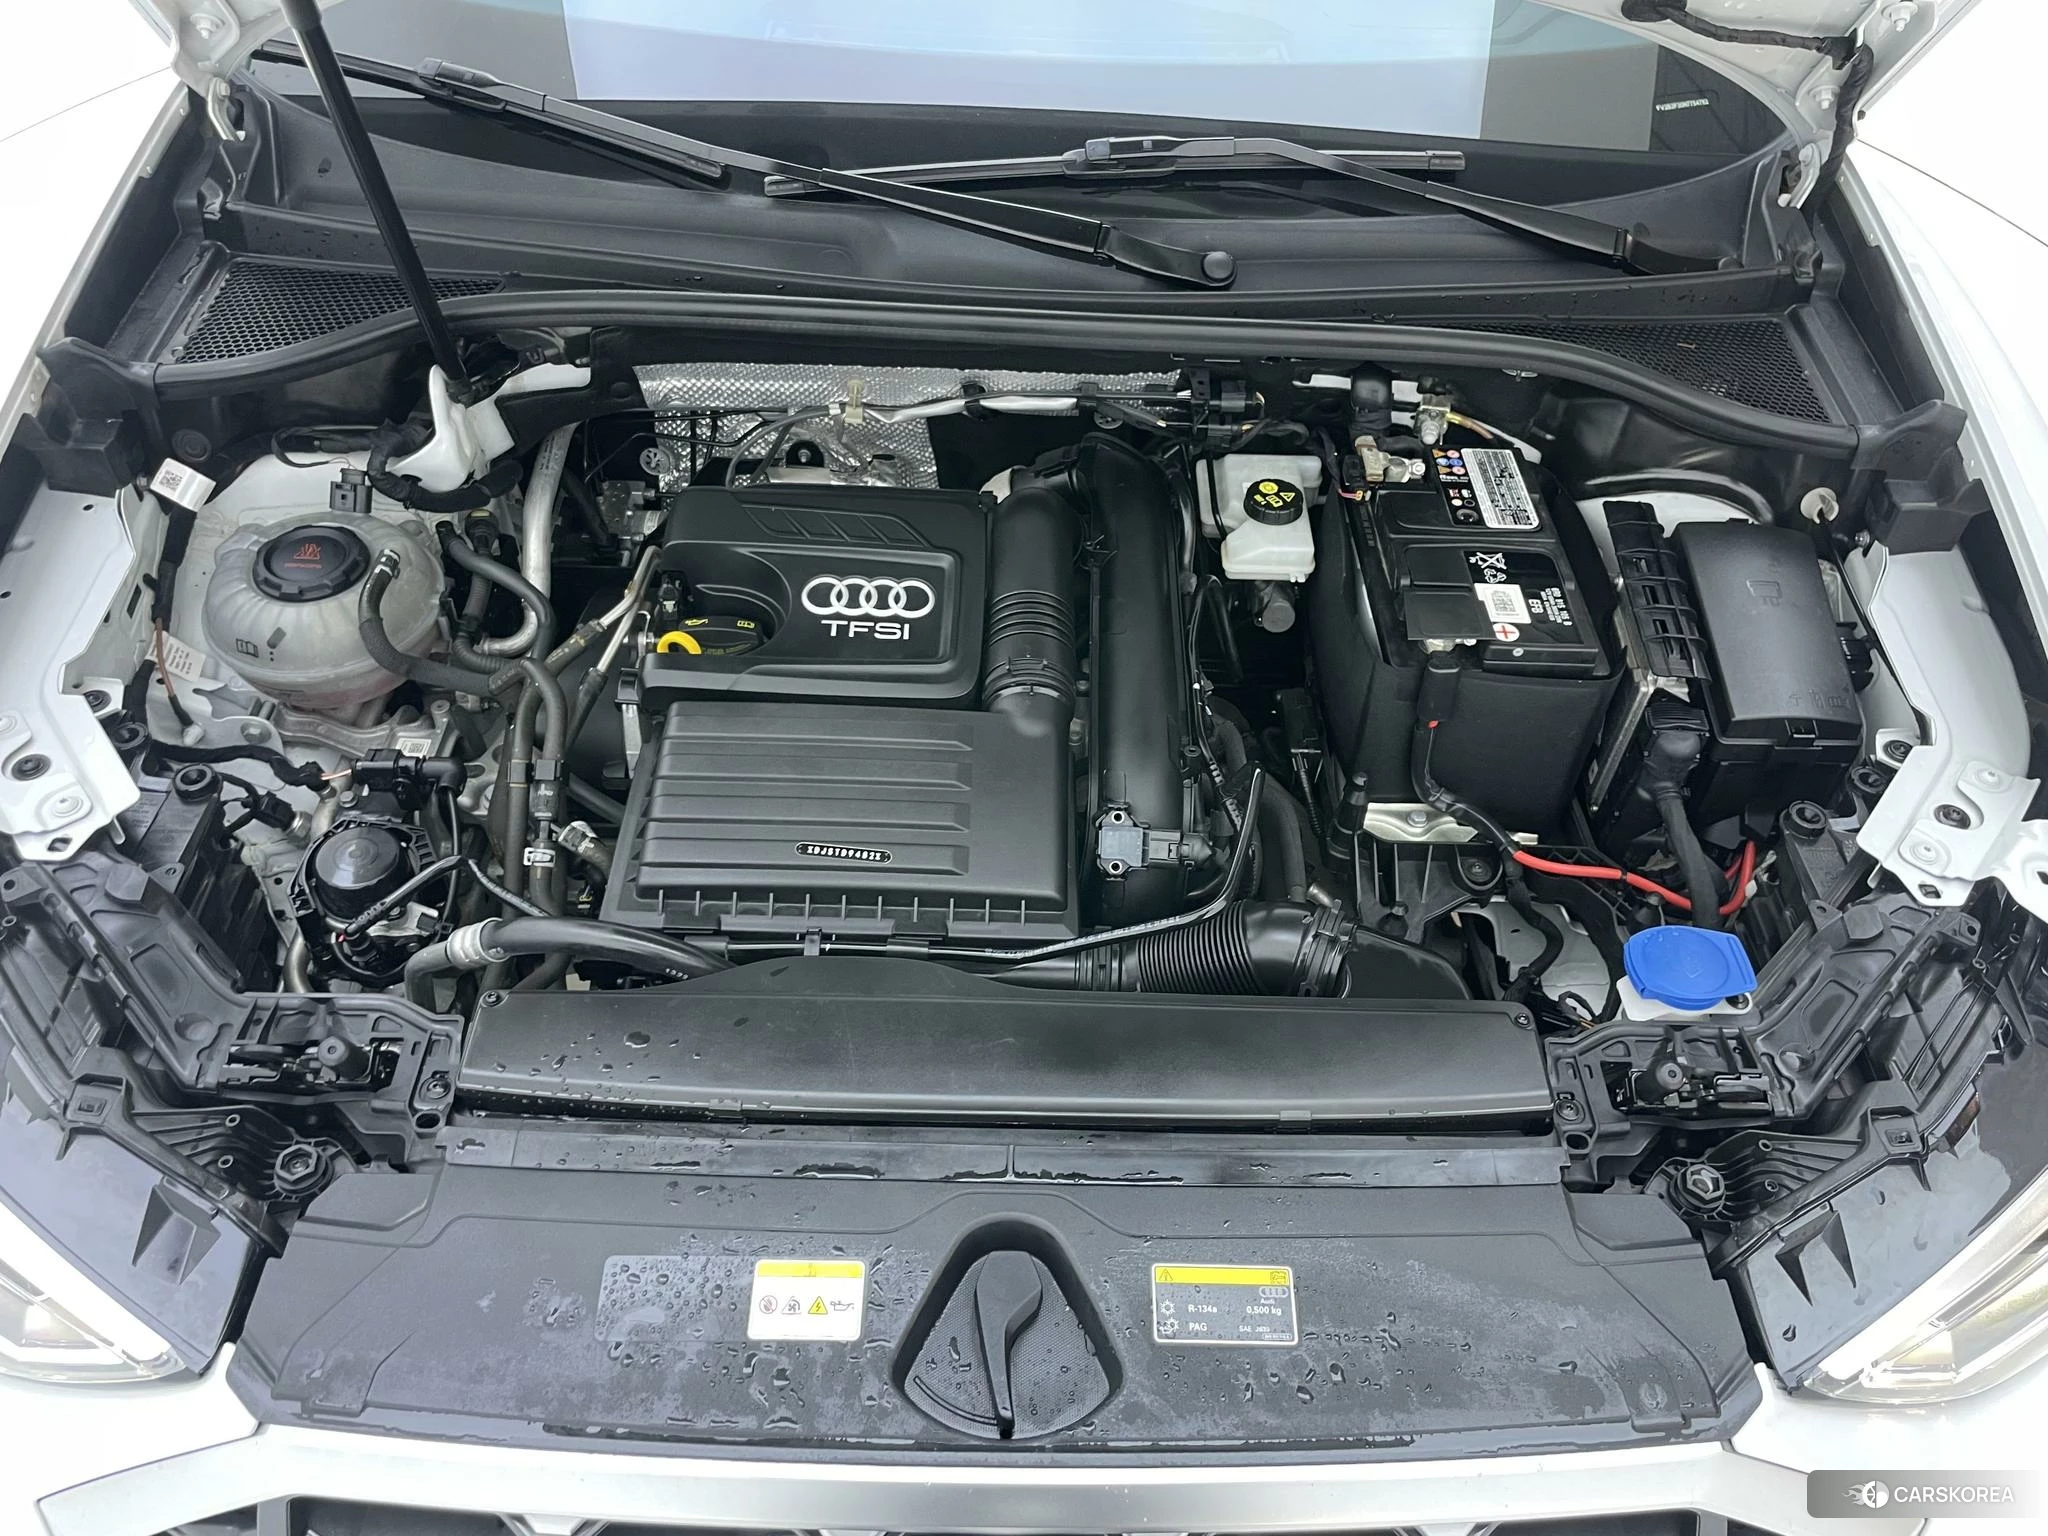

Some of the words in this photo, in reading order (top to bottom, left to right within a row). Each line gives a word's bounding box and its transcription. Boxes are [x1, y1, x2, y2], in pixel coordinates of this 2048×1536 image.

[1528, 599, 1544, 613] EFB
[821, 620, 910, 640] TFSI
[1188, 1304, 1218, 1313] R-134a
[1270, 1305, 1282, 1316] kg
[1189, 1322, 1208, 1331] PAG
